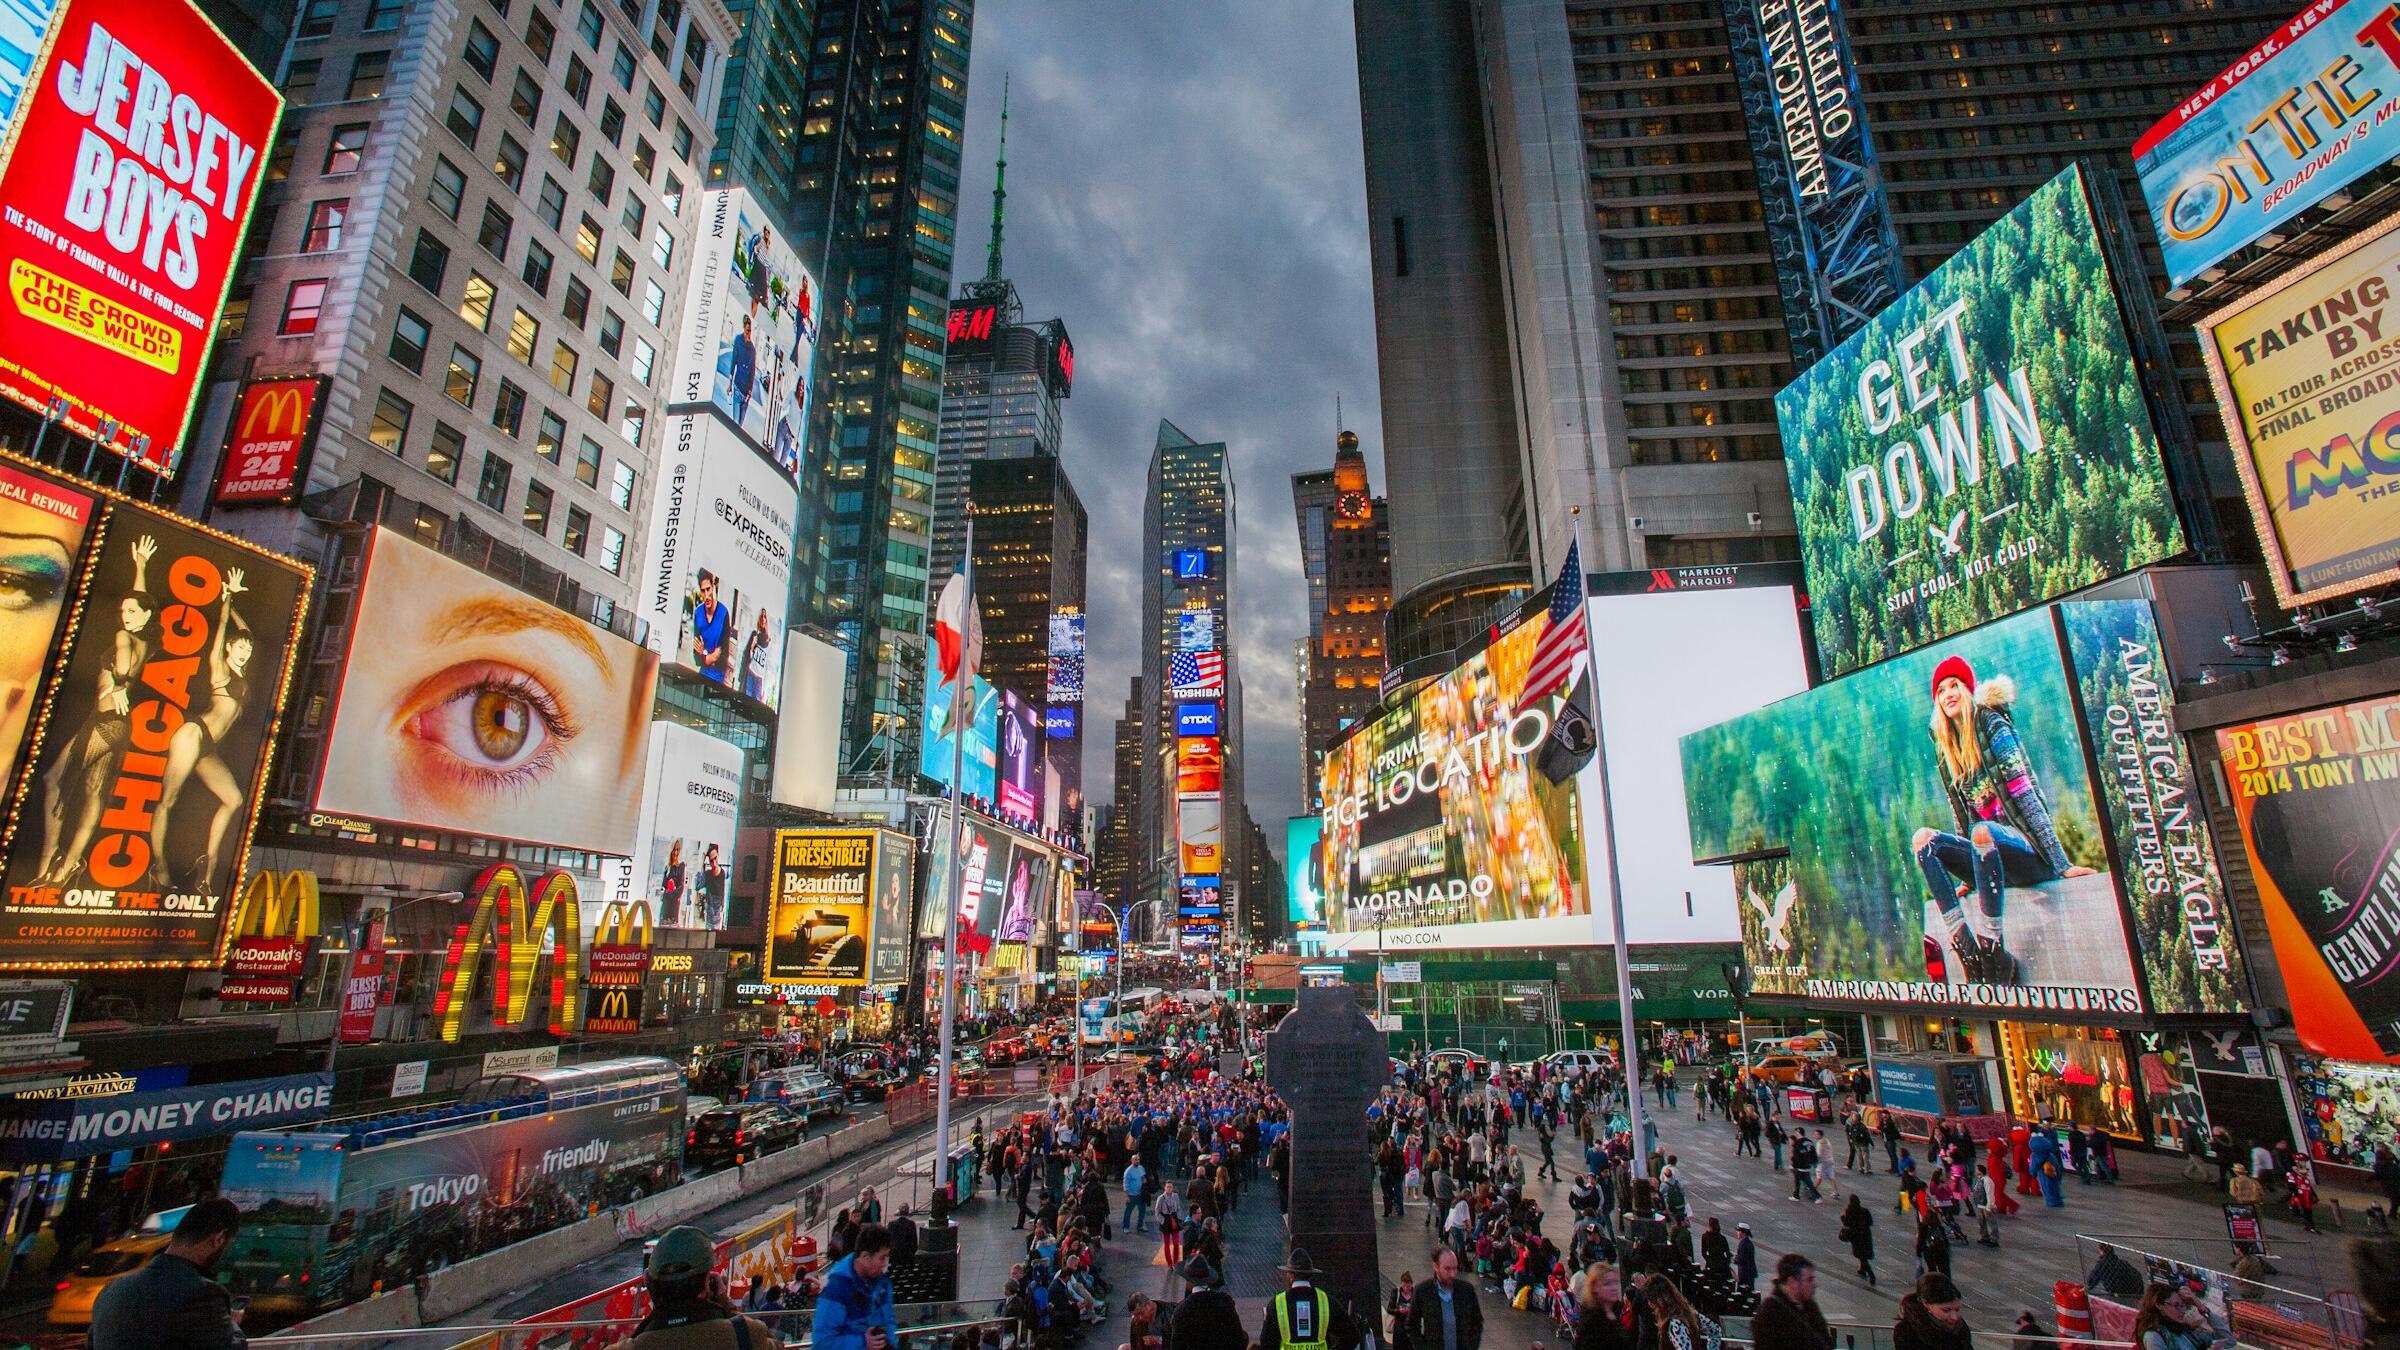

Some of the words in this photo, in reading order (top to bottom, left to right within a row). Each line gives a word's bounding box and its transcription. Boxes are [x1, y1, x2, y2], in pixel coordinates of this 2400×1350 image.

[2178, 84, 2217, 121] NEW
[2221, 39, 2284, 86] YORK,
[2288, 0, 2336, 38] NEW
[57, 22, 256, 221] JERSEY
[1769, 21, 1829, 196] AMERICAN
[2163, 139, 2275, 242] ON
[2245, 54, 2382, 160] THE
[2262, 119, 2369, 213] BROADWAY'S
[65, 128, 208, 290] BOYS
[712, 190, 728, 239] RUNWAY
[5, 205, 24, 229] THE
[25, 218, 57, 246] STORY
[56, 236, 70, 252] OF
[70, 243, 106, 274] FRANKIE
[107, 262, 130, 288] VALLI
[130, 278, 138, 293] &
[139, 281, 153, 302] THE
[153, 291, 173, 312] FOUR
[172, 300, 205, 330] SEASONS
[22, 287, 95, 329] GOES
[88, 298, 173, 345] CROWD
[2234, 276, 2390, 367] TAKING
[2325, 308, 2384, 360] BY
[21, 368, 52, 391] Wilson
[1858, 299, 1970, 436] GET
[2253, 396, 2275, 416] ON
[2281, 375, 2325, 404] TOUR
[2259, 409, 2316, 441] FINAL
[241, 440, 293, 455] OPEN
[1845, 366, 2044, 543] DOWN
[240, 455, 283, 477] 24
[224, 478, 289, 493] HOURS
[30, 492, 79, 520] REVIVAL
[654, 463, 688, 614] @EXPRESSRUNWAY
[1679, 567, 1738, 577] MARRIOTT
[1680, 576, 1733, 586] MARQUIS
[1887, 588, 1915, 612] STAY
[1920, 576, 1959, 600] COOL.
[1963, 556, 1990, 580] NOT
[1998, 537, 2044, 565] COLD.
[1186, 601, 1207, 609] 2014
[1173, 687, 1221, 698] TOSHIBA
[88, 555, 223, 889] CHICAGO
[1190, 715, 1213, 724] TDK
[1377, 730, 1430, 775] PRIME
[2228, 714, 2338, 772] BEST
[1323, 794, 1369, 834] FICE
[1377, 708, 1549, 813] LOCATIO
[2240, 768, 2293, 798] 2014
[2294, 758, 2355, 791] TONY
[2106, 703, 2171, 896] OUTFITTERS
[2118, 637, 2194, 832] AMERICAN
[2169, 844, 2228, 971] EAGLE
[9, 886, 60, 906] THE
[64, 889, 115, 908] ONE
[118, 891, 161, 909] THE
[164, 893, 220, 911] ONLY
[784, 873, 865, 893] Beautiful
[1353, 874, 1494, 915] VORNADO
[5, 906, 19, 914] THE
[20, 907, 86, 915] LONGEST-RUNNING
[784, 895, 795, 903] The
[820, 895, 836, 905] King
[837, 895, 863, 904] Musical
[1420, 905, 1468, 917] TRUST
[2318, 886, 2350, 914] A
[19, 926, 197, 939] CHICAGOTHEMUSICAL.COM
[1390, 932, 1442, 945] VNO.COM
[228, 945, 302, 962] McDonald's
[236, 961, 288, 971] Restaurant
[592, 952, 648, 962] McDonald's
[652, 955, 692, 971] XPRESS
[221, 986, 245, 994] OPEN
[246, 986, 257, 995] 24
[259, 986, 289, 995] HOURS
[347, 975, 382, 993] JERSEY
[737, 984, 772, 993] GIFTS
[781, 984, 838, 996] LUGGAGE
[1810, 979, 1902, 1001] AMERICAN
[1907, 982, 1970, 1003] EAGLE
[1975, 985, 2139, 1013] OUTFITTERS
[351, 992, 375, 1011] BOYS
[15, 1086, 65, 1100] MONEY
[66, 1079, 136, 1097] EXCHANGE
[67, 1100, 205, 1143] MONEY
[211, 1085, 334, 1122] CHANGE
[614, 1102, 650, 1117] UNITED
[541, 1138, 610, 1175] friendly
[408, 1173, 480, 1210] Tokyo
